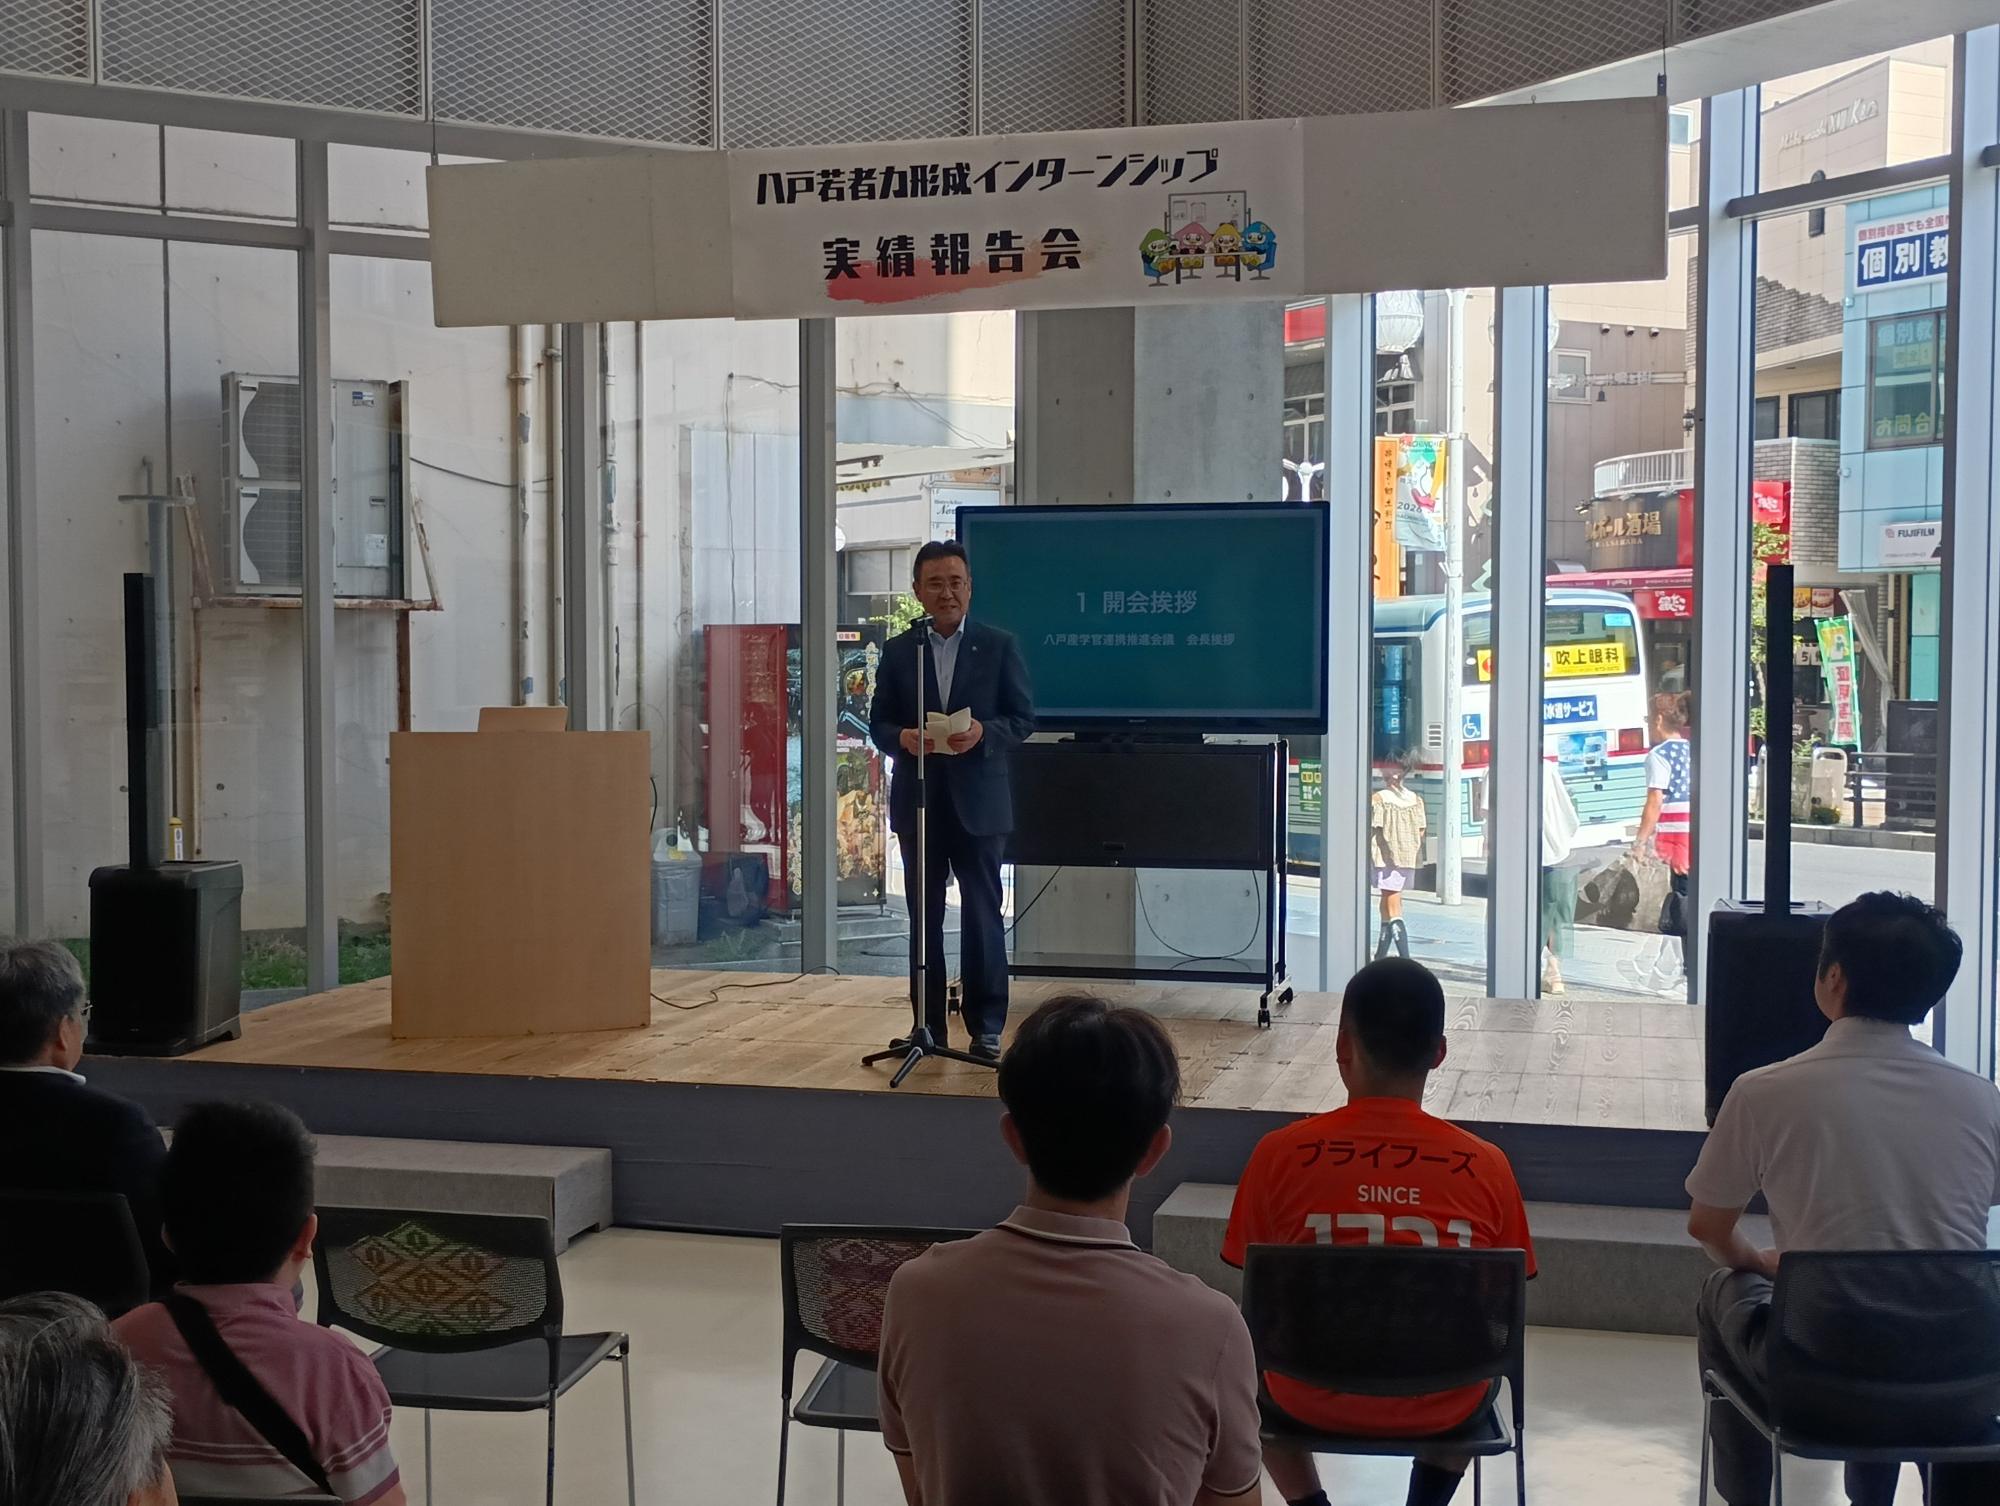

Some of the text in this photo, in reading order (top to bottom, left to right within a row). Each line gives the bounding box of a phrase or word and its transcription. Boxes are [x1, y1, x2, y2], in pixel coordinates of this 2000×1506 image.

[756, 148, 1220, 205] 八戸若者力形成インターンシップ
[822, 227, 1082, 280] 実績報告会
[1897, 528, 1935, 537] FUJIFILM
[1103, 591, 1198, 614] 開会挨拶
[1556, 647, 1619, 665] 吹上眼科
[1297, 1139, 1477, 1178] プライフーズ
[1358, 1184, 1421, 1205] SINCE
